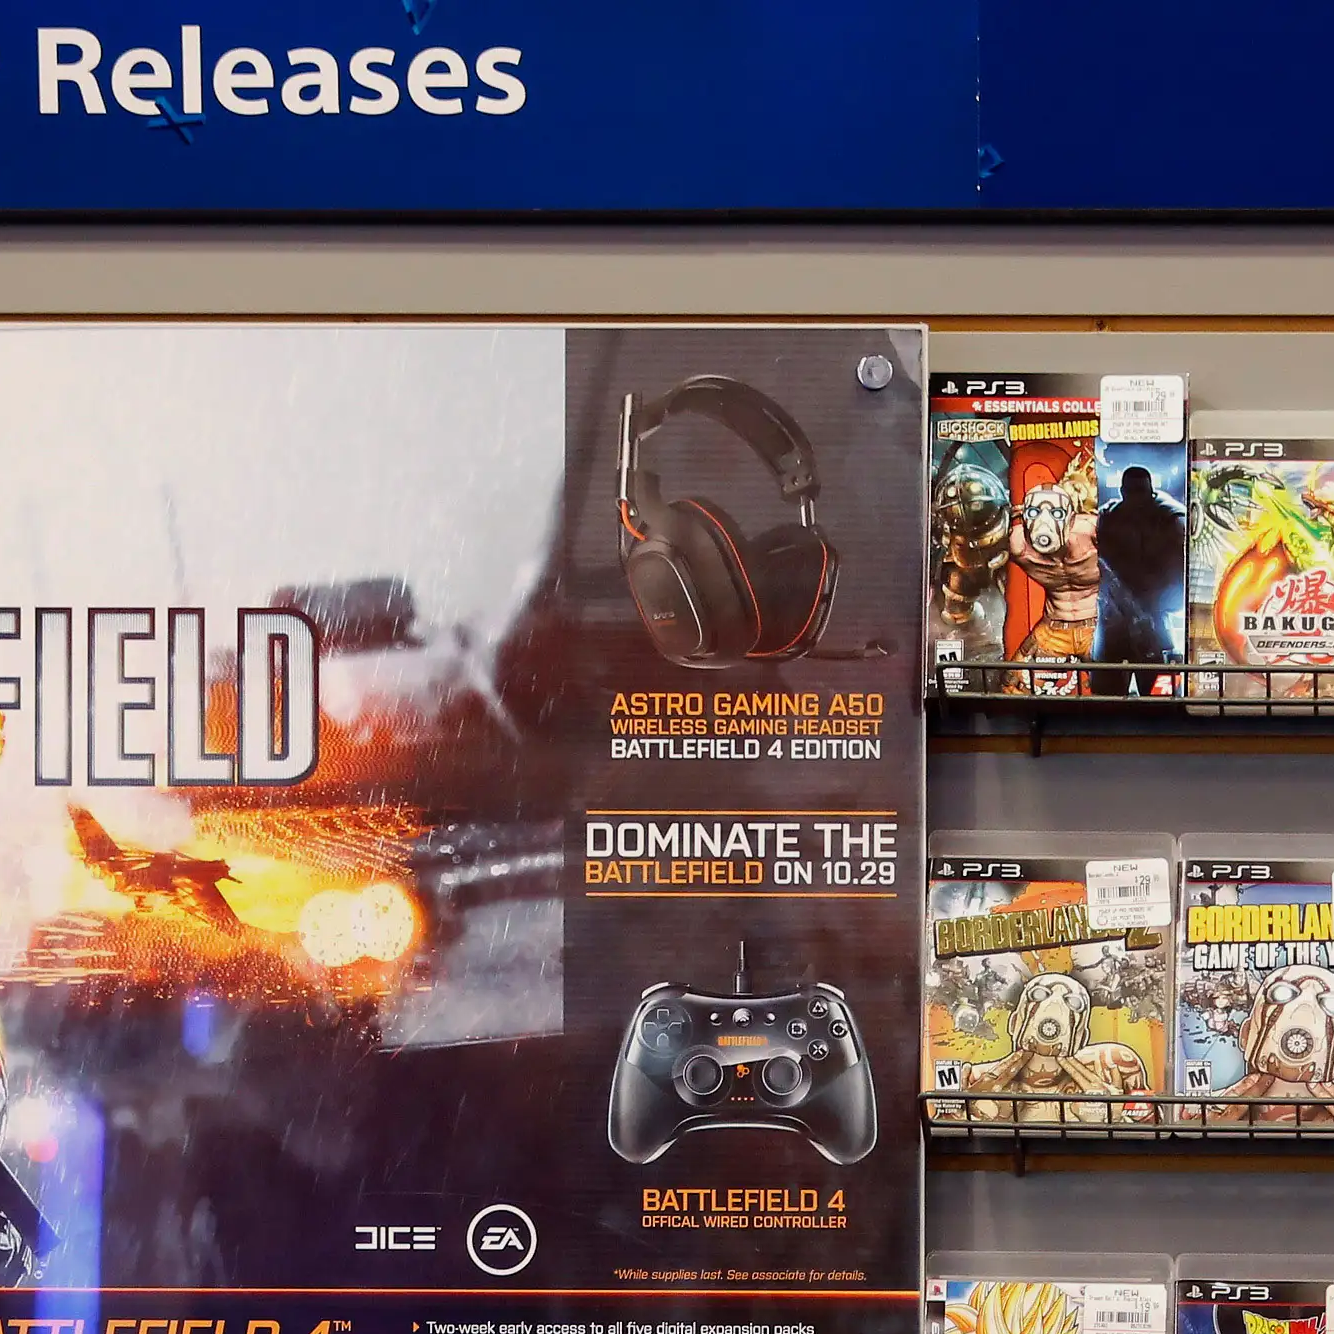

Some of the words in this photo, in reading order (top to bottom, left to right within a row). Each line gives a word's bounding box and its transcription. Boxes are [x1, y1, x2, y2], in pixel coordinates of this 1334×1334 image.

[37, 24, 526, 116] Releases
[967, 380, 1026, 395] PS3
[985, 401, 1059, 413] ESSENTIALS
[1009, 419, 1099, 441] BORDERLANDS
[610, 692, 703, 716] ASTRO
[713, 690, 819, 716] GAMING
[828, 693, 884, 716] A50
[610, 718, 707, 735] WIRELESS
[714, 718, 788, 737] GAMING
[793, 718, 883, 736] HEADSET
[611, 738, 760, 759] BATTLEFIELD
[767, 738, 784, 759] 4
[790, 739, 881, 760] EDITION
[586, 822, 801, 858] DOMINATE
[813, 822, 898, 859] THE
[585, 860, 763, 884] BATTLEFIELD
[773, 860, 813, 885] ON
[821, 861, 895, 885] 10.29
[1194, 943, 1248, 970] GAME
[1255, 942, 1280, 968] OF
[1286, 941, 1320, 967] THE
[642, 1188, 818, 1212] BATTLEFIELD
[827, 1189, 846, 1212] 4
[642, 1215, 700, 1228] OFFICAL
[703, 1215, 749, 1228] WIRED
[753, 1215, 847, 1229] CONTROLLER
[479, 1223, 523, 1251] EA
[651, 1268, 698, 1283] supplies
[699, 1268, 724, 1280] last.
[726, 1269, 749, 1281] See
[751, 1269, 806, 1281] associate
[808, 1269, 826, 1283] for
[827, 1269, 867, 1281] details.
[425, 1320, 496, 1334] Two-week
[536, 1324, 586, 1334] access
[589, 1321, 604, 1334] to
[607, 1321, 623, 1334] all
[625, 1321, 653, 1334] five
